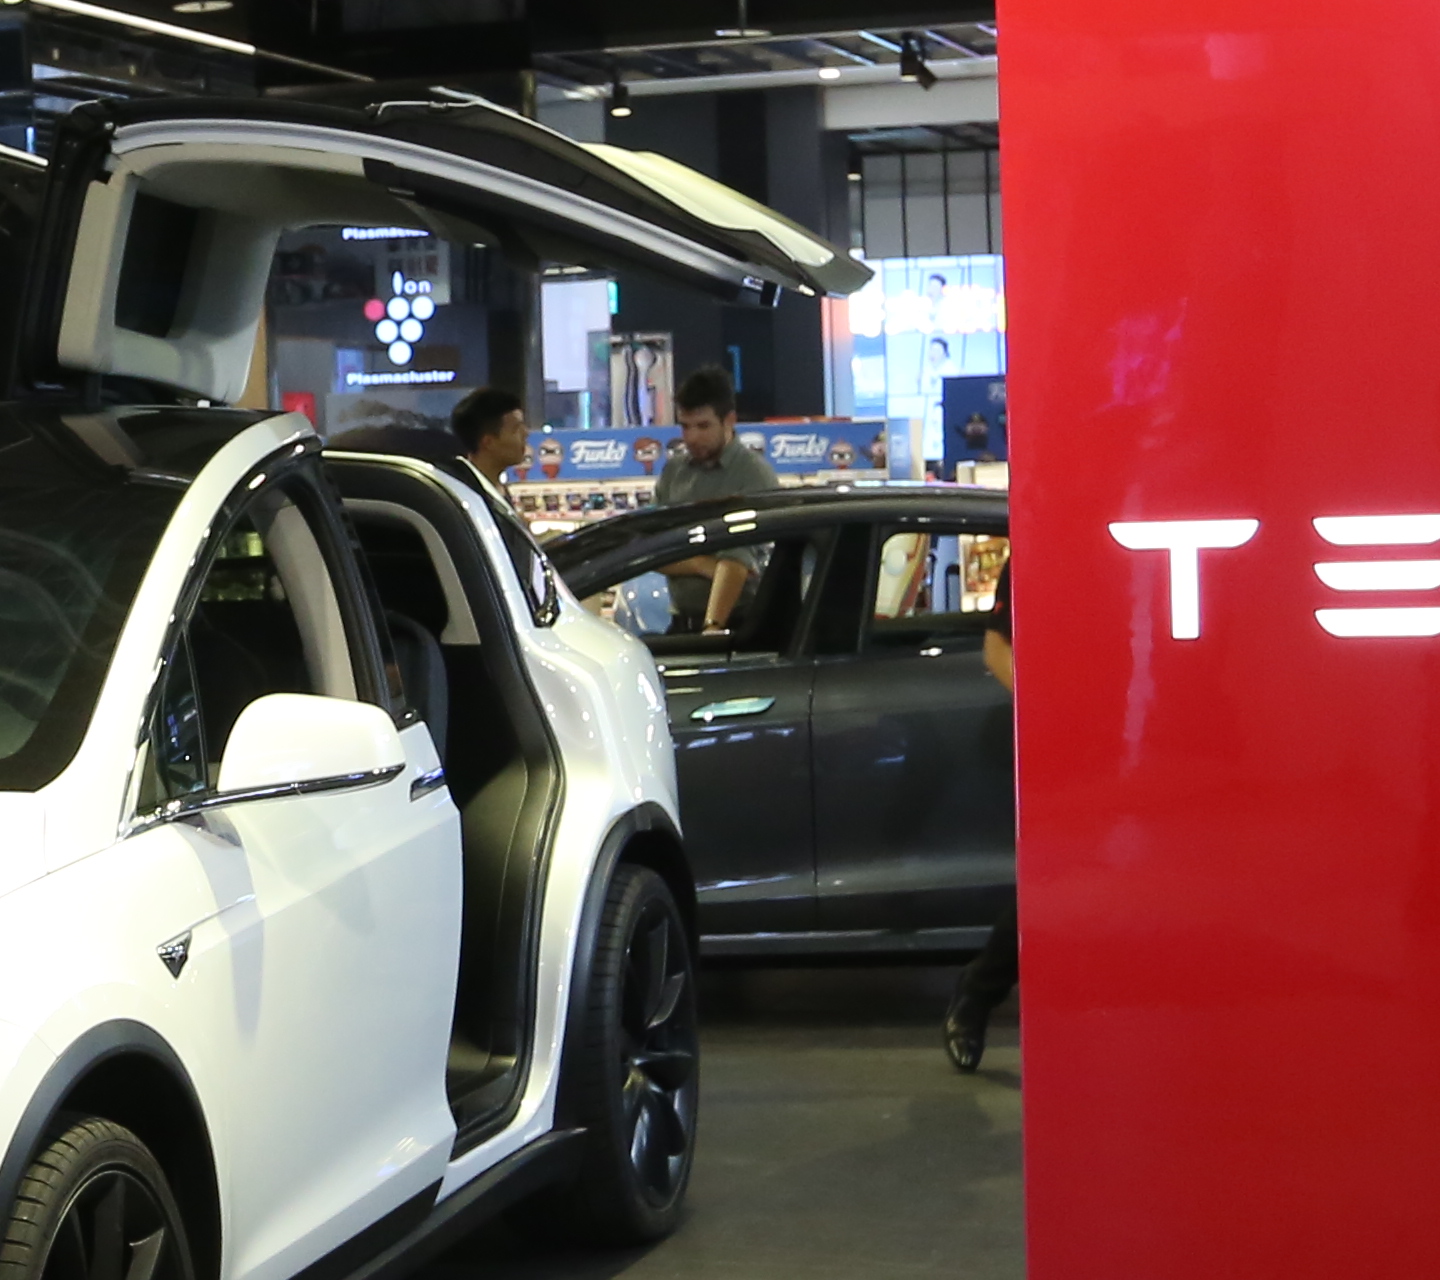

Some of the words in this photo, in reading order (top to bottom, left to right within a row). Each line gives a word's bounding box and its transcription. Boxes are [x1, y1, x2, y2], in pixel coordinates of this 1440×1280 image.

[346, 370, 456, 386] Plasmacluster
[570, 438, 628, 464] Funko
[770, 432, 829, 460] Funko
